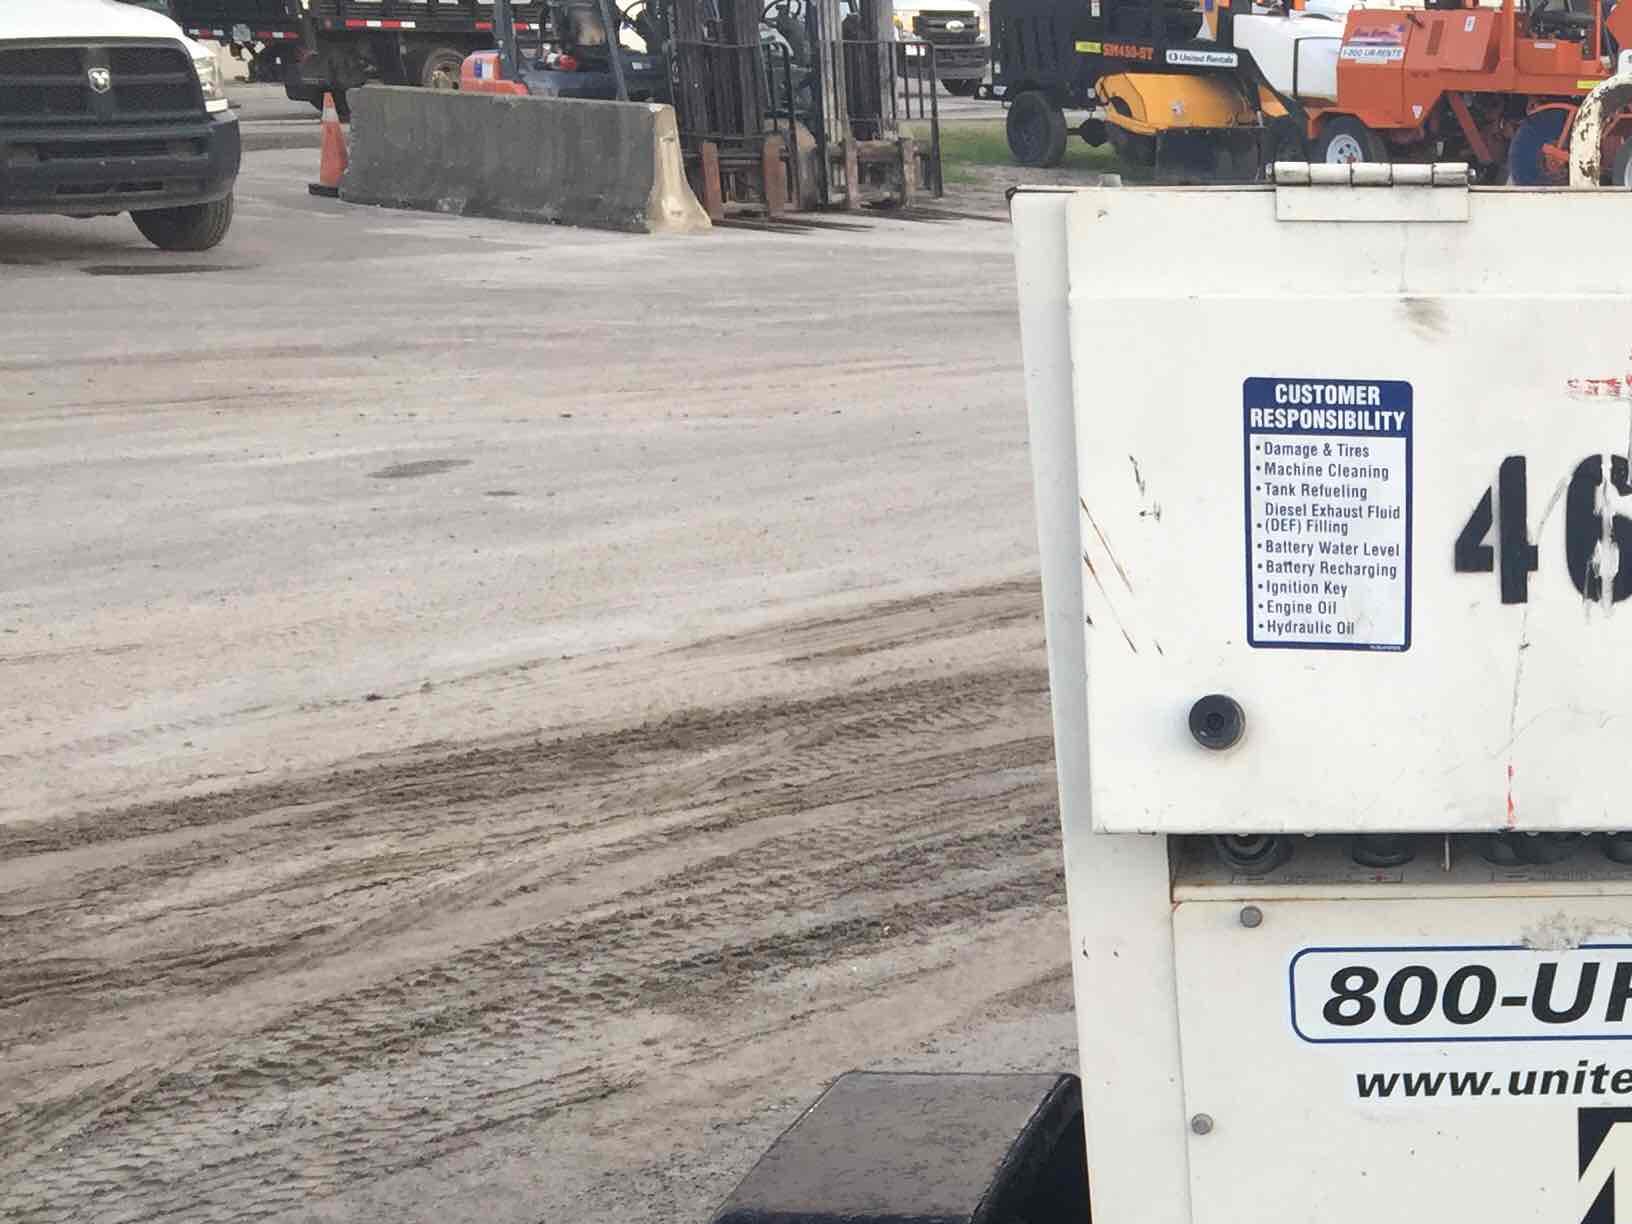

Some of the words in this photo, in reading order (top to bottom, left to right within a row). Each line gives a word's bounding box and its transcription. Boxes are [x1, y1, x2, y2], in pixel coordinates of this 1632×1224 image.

[1274, 383, 1381, 406] CUSTOMER
[1250, 408, 1407, 432] RESPONSIBILITY
[1264, 441, 1318, 459] Damage
[1323, 443, 1333, 457] &
[1336, 443, 1370, 458] Tires
[1264, 462, 1323, 477] Machine
[1328, 463, 1389, 481] Cleaning
[1264, 482, 1296, 497] Tank
[1301, 483, 1368, 501] Refueling
[1265, 502, 1307, 517] Diesel
[1311, 503, 1363, 519] Exhaust
[1367, 504, 1401, 520] Fluid
[1264, 519, 1302, 535] (DEF)
[1306, 519, 1349, 536] Filling
[1265, 540, 1315, 558] Battery
[1319, 541, 1359, 557] Water
[1363, 542, 1401, 558] Level
[1266, 560, 1316, 578] Battery
[1320, 560, 1397, 580] Recharging
[1266, 580, 1319, 597] Ignition
[1323, 581, 1348, 598] Key
[1267, 600, 1313, 616] Engine
[1317, 601, 1337, 615] Oil
[1267, 620, 1332, 637] Hydraulic
[1336, 621, 1355, 635] Oil
